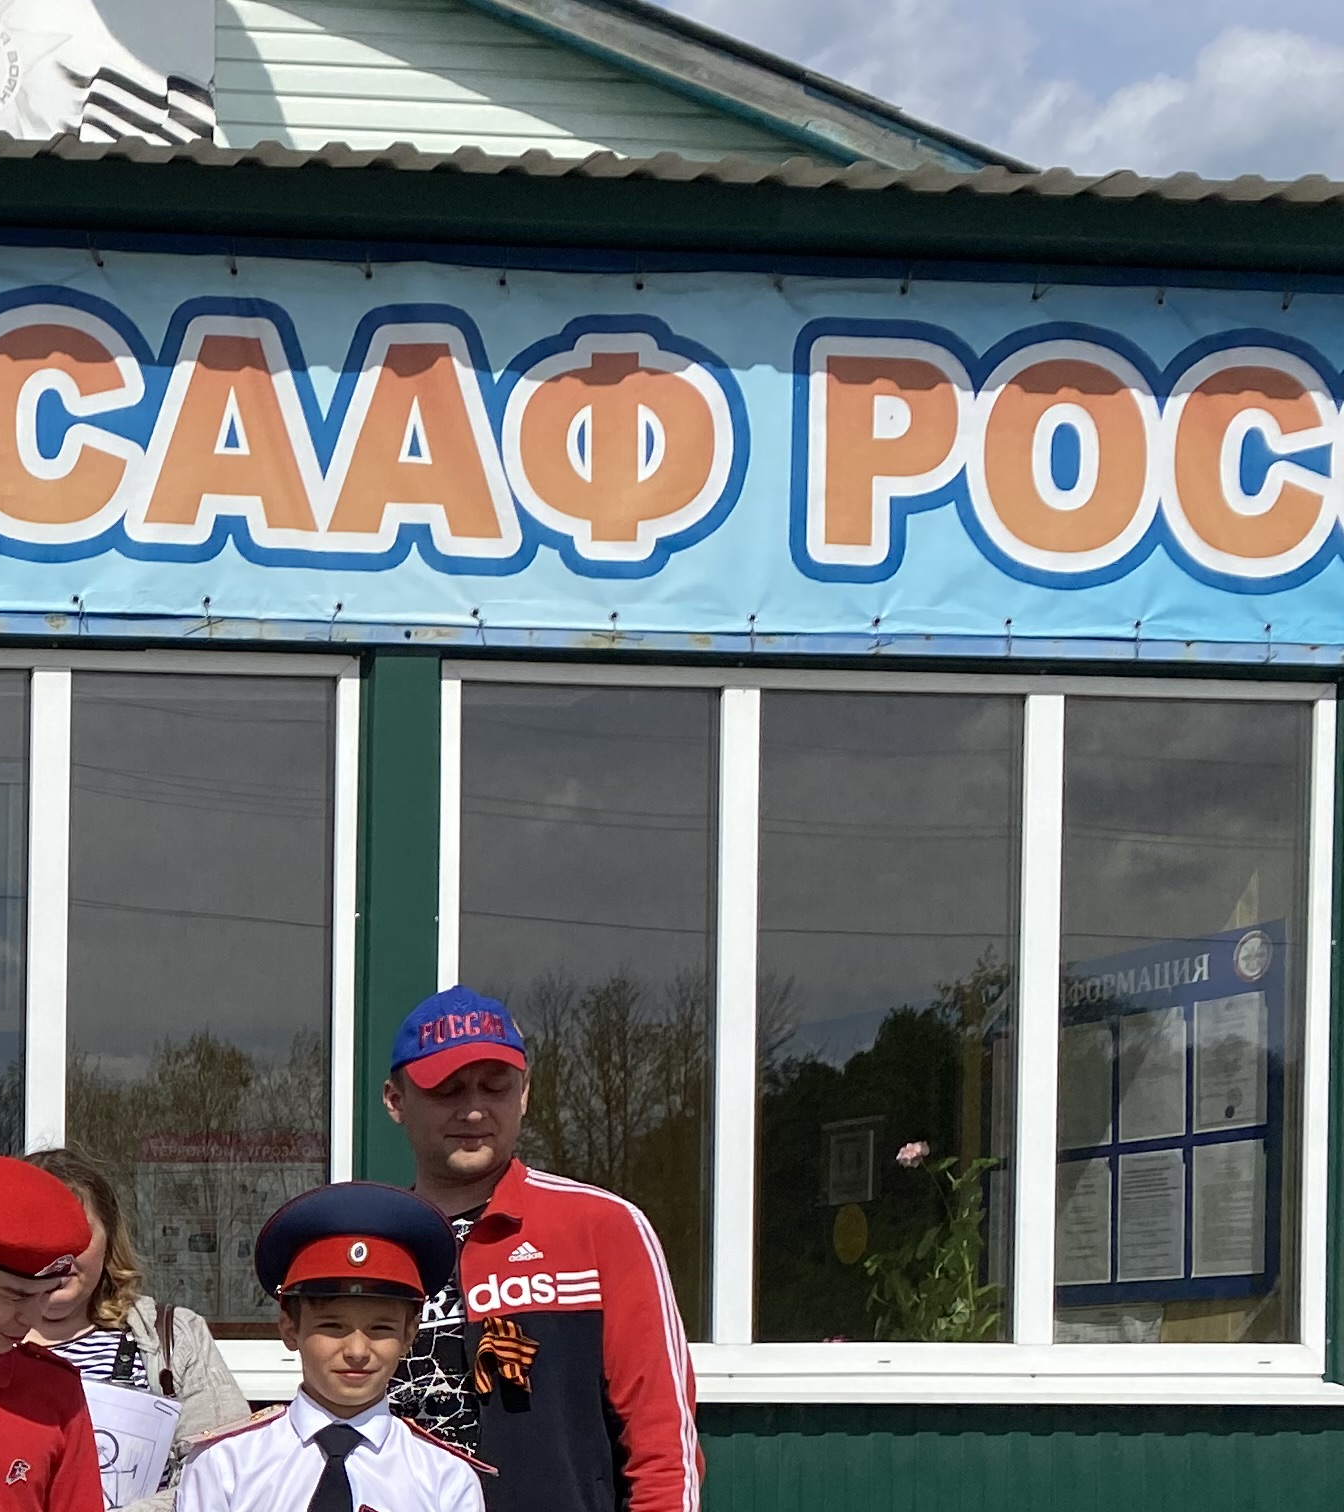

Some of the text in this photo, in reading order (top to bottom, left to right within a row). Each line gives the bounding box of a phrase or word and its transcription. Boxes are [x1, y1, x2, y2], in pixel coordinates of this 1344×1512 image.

[807, 334, 1344, 579] РОС
[1061, 953, 1211, 1008] ФОРМАЦИЯ
[419, 1010, 507, 1051] РОССИЯ
